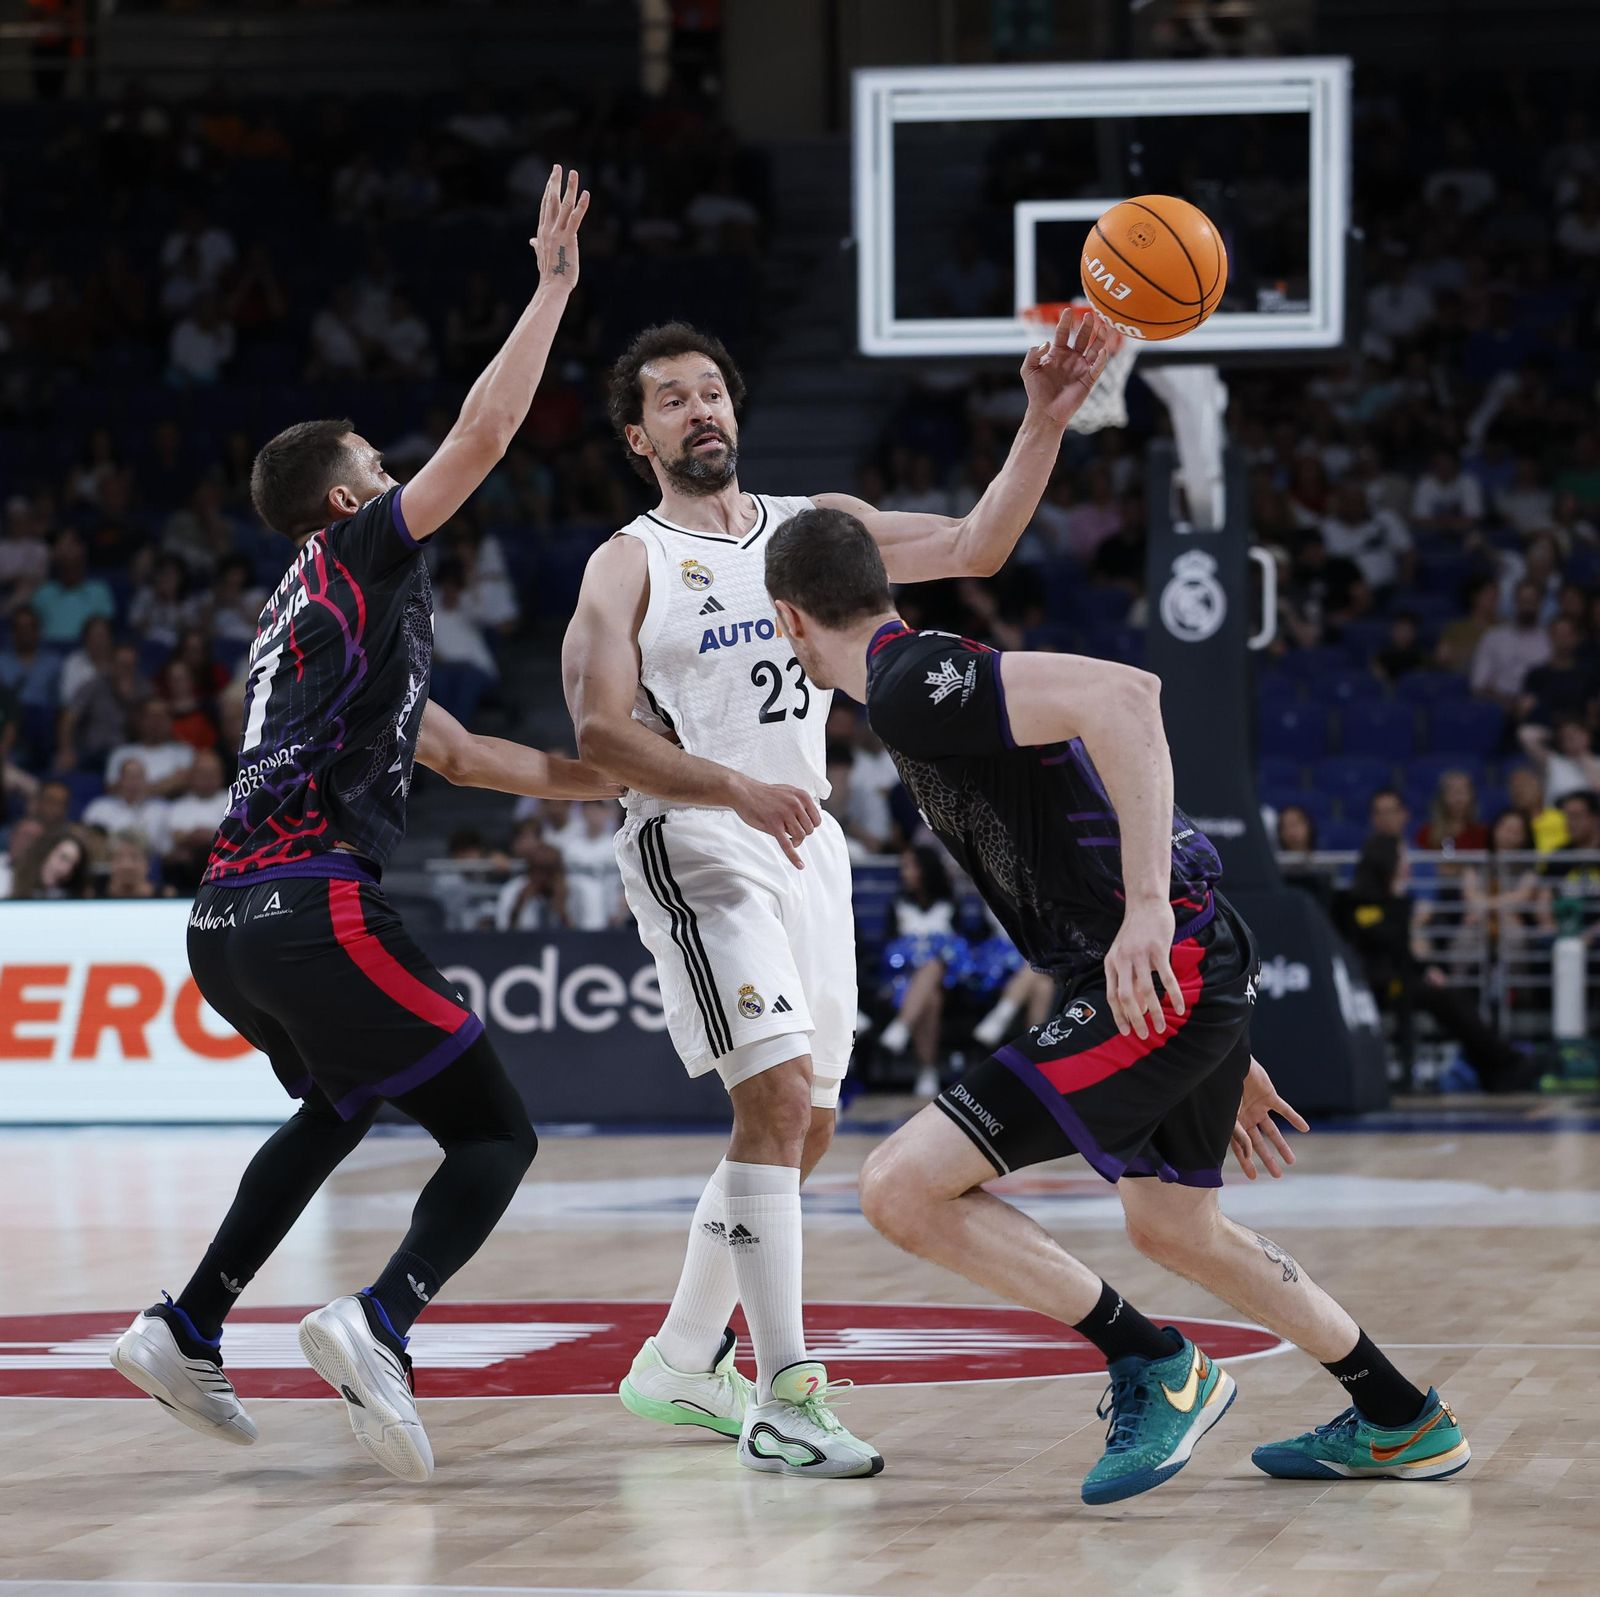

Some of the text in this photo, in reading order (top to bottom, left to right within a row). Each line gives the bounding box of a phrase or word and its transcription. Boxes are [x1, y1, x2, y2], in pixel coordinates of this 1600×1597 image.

[1087, 257, 1132, 301] EVO
[242, 643, 284, 753] 7
[751, 656, 810, 724] 23
[950, 1083, 1004, 1137] SPALDING
